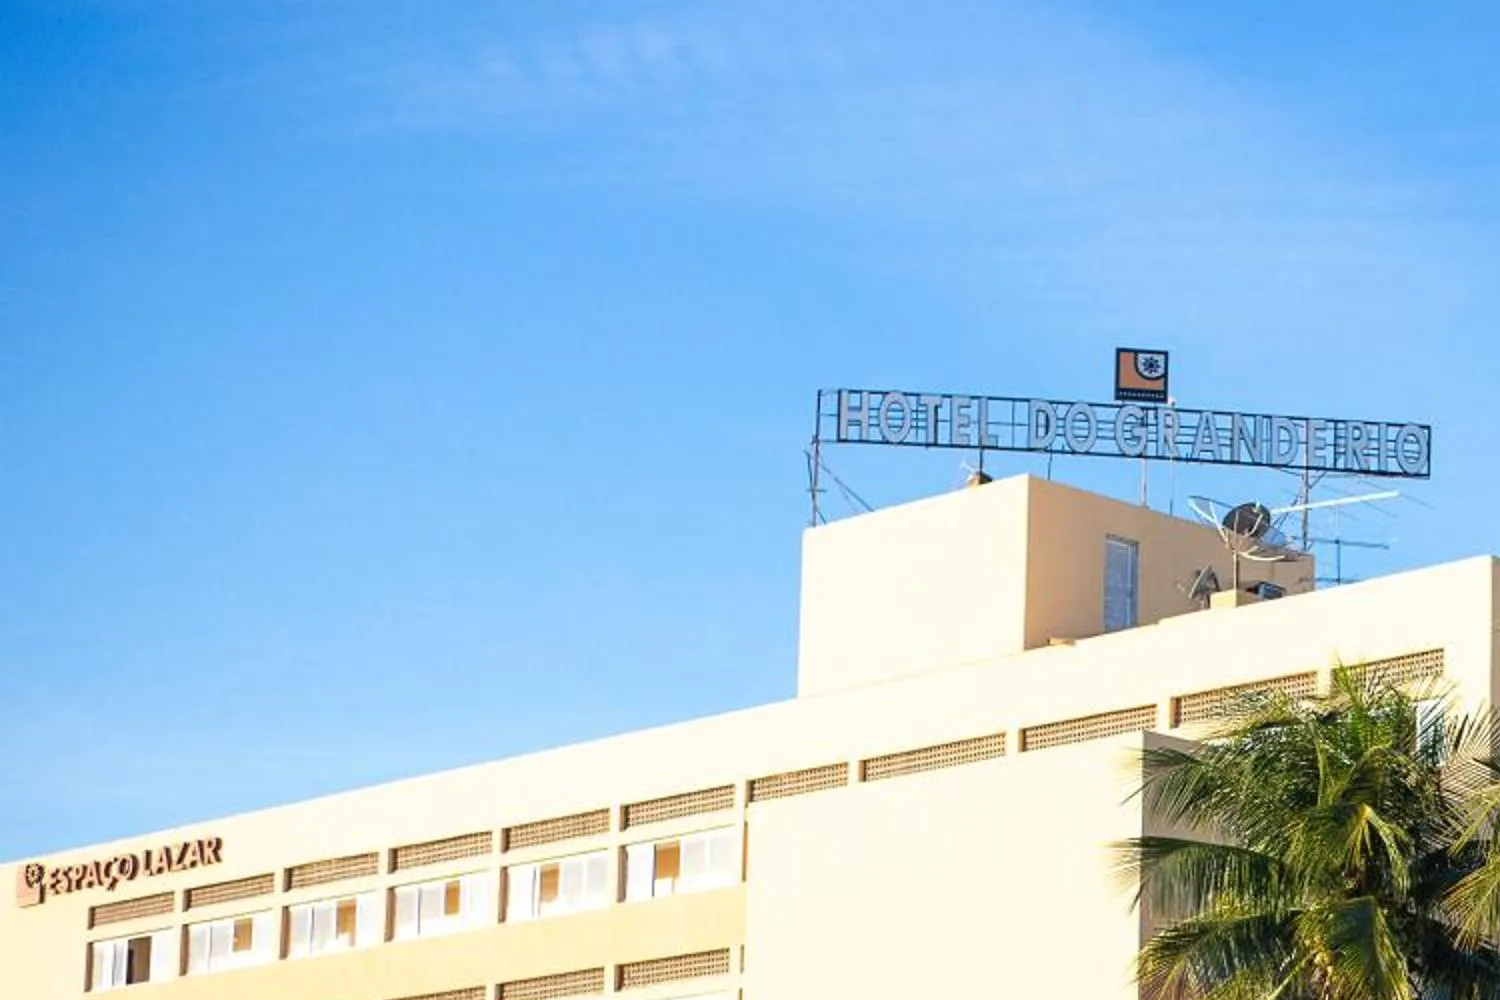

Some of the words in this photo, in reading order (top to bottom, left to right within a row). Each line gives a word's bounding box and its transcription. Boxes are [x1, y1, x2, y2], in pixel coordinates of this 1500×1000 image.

[839, 391, 999, 447] HOTEL
[1029, 399, 1097, 453] DO
[50, 853, 140, 894] ESPAÇO
[143, 837, 223, 876] LAZAR
